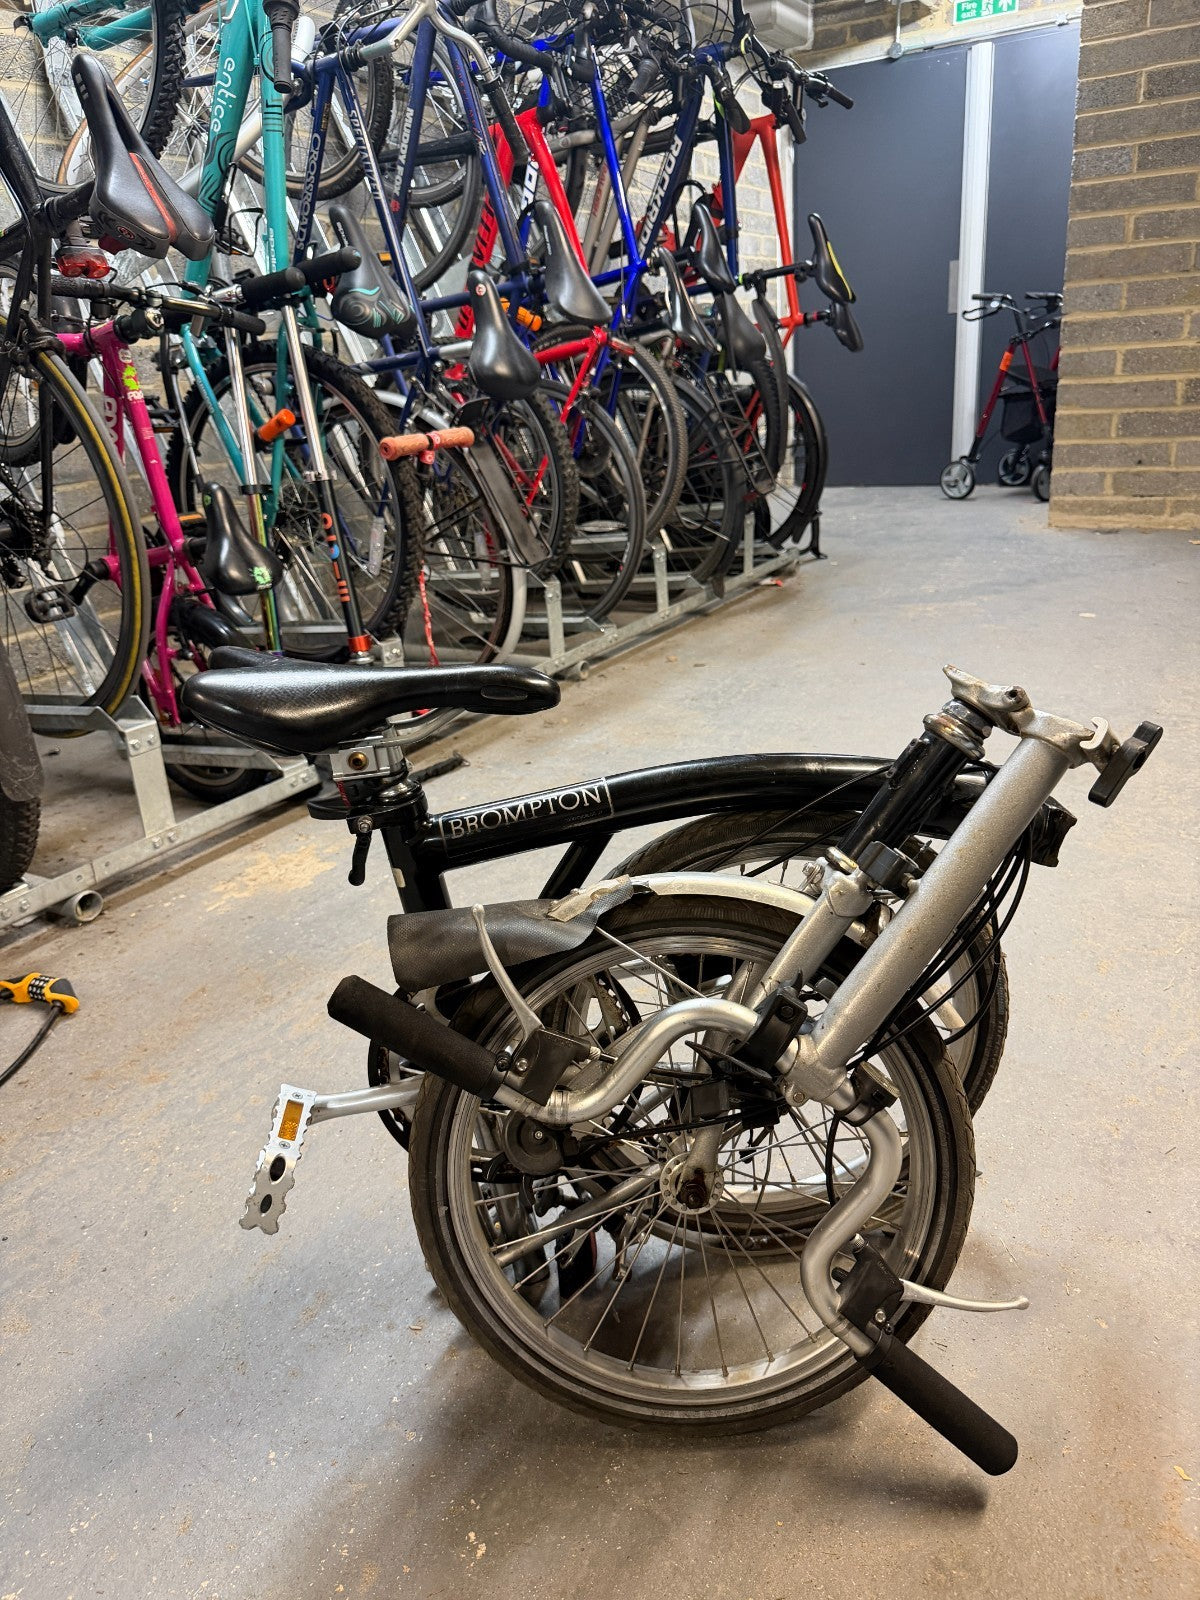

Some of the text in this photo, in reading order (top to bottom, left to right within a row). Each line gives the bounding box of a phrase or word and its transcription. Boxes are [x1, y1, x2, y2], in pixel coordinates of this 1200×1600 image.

[961, 2, 977, 11] Fire
[961, 9, 976, 18] exit
[210, 57, 237, 133] entice
[296, 132, 321, 250] CROSSROADS
[350, 109, 382, 200] SPECIALIZED
[393, 106, 414, 196] MUDDY FOX
[637, 133, 683, 261] ROCKRIDE
[449, 785, 602, 840] BROMPTON
